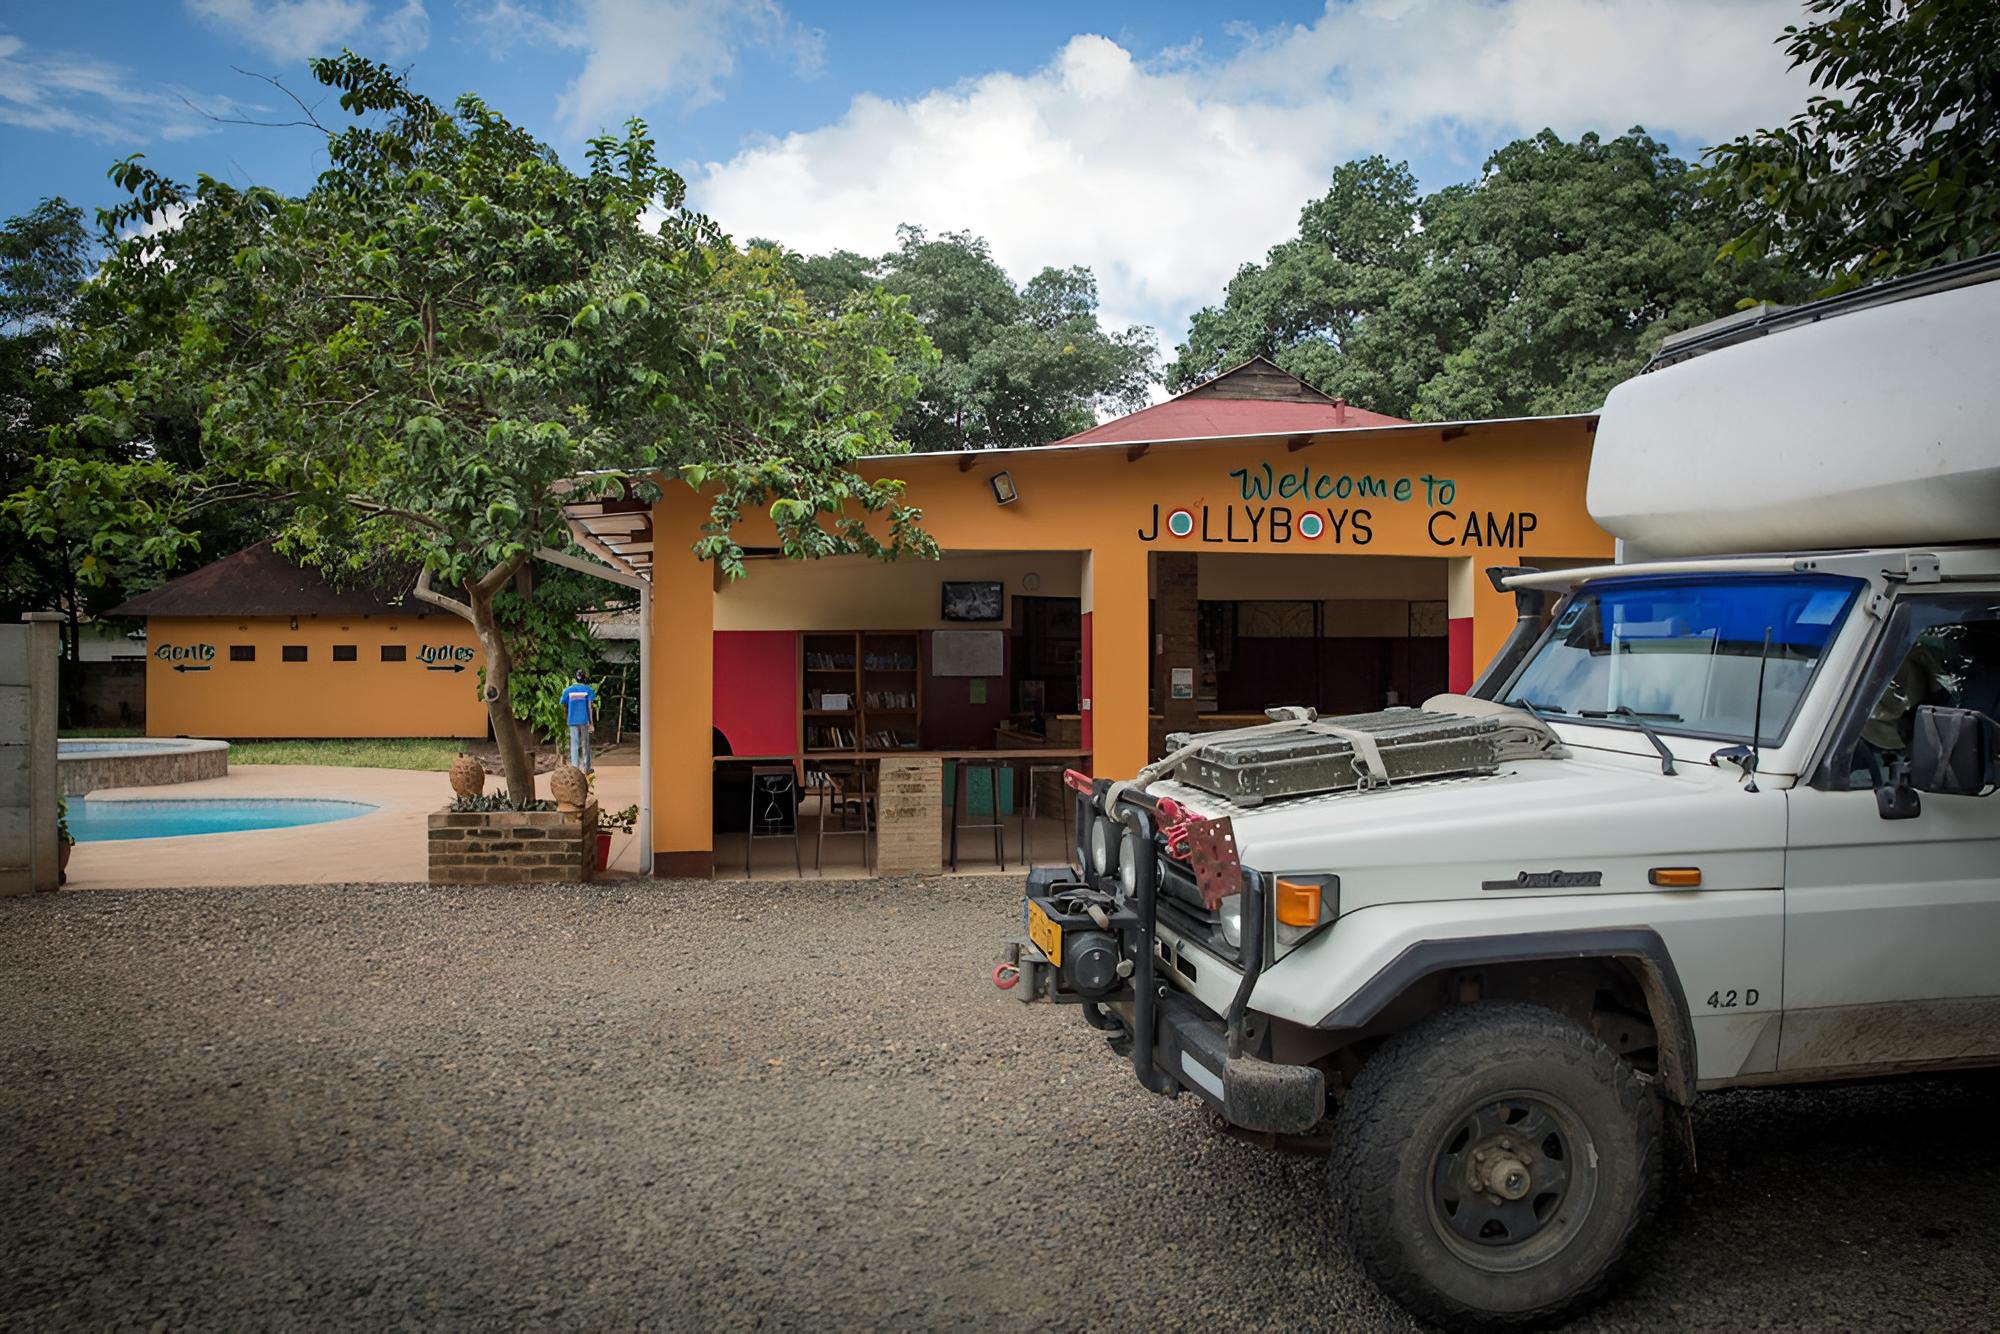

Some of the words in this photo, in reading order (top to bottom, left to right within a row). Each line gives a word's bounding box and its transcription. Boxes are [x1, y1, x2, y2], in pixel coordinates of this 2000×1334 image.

[1229, 463, 1412, 504] Welcome
[1420, 474, 1456, 507] to
[1137, 503, 1373, 544] JOLLYBOYS
[1427, 511, 1538, 549] CAMP
[1707, 989, 1738, 1009] 4.2
[1745, 988, 1760, 1007] D
